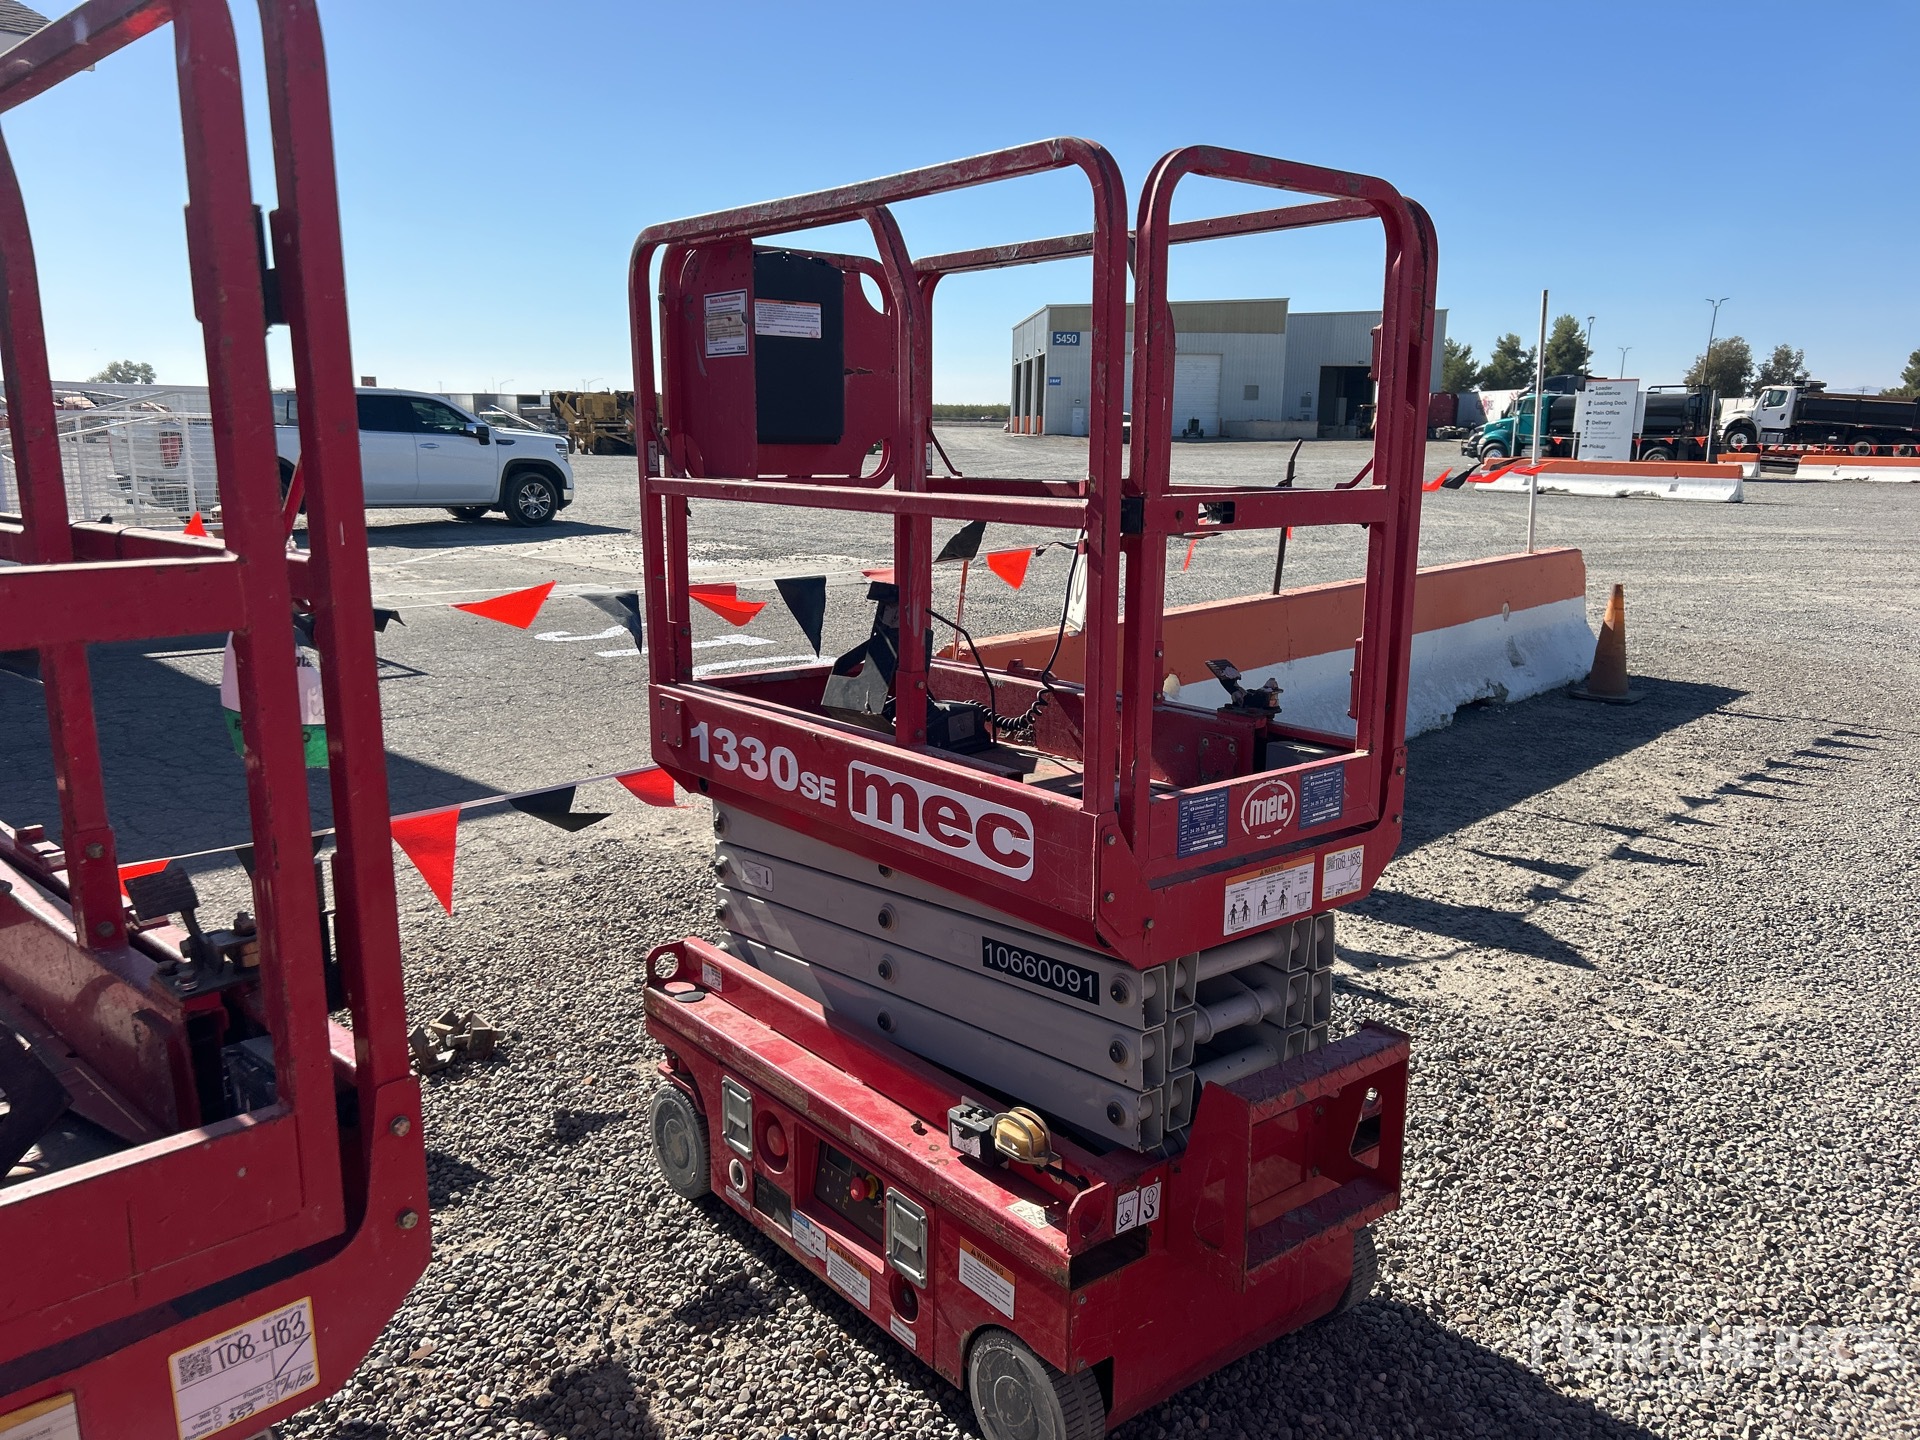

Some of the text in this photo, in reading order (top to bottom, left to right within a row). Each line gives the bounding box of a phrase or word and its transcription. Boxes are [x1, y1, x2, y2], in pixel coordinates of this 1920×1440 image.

[1056, 334, 1078, 343] 5450
[852, 768, 1031, 869] mec
[1250, 793, 1288, 827] mec
[1264, 864, 1284, 873] WARNING
[985, 943, 1093, 997] 10660091
[977, 1253, 1003, 1275] WARNING
